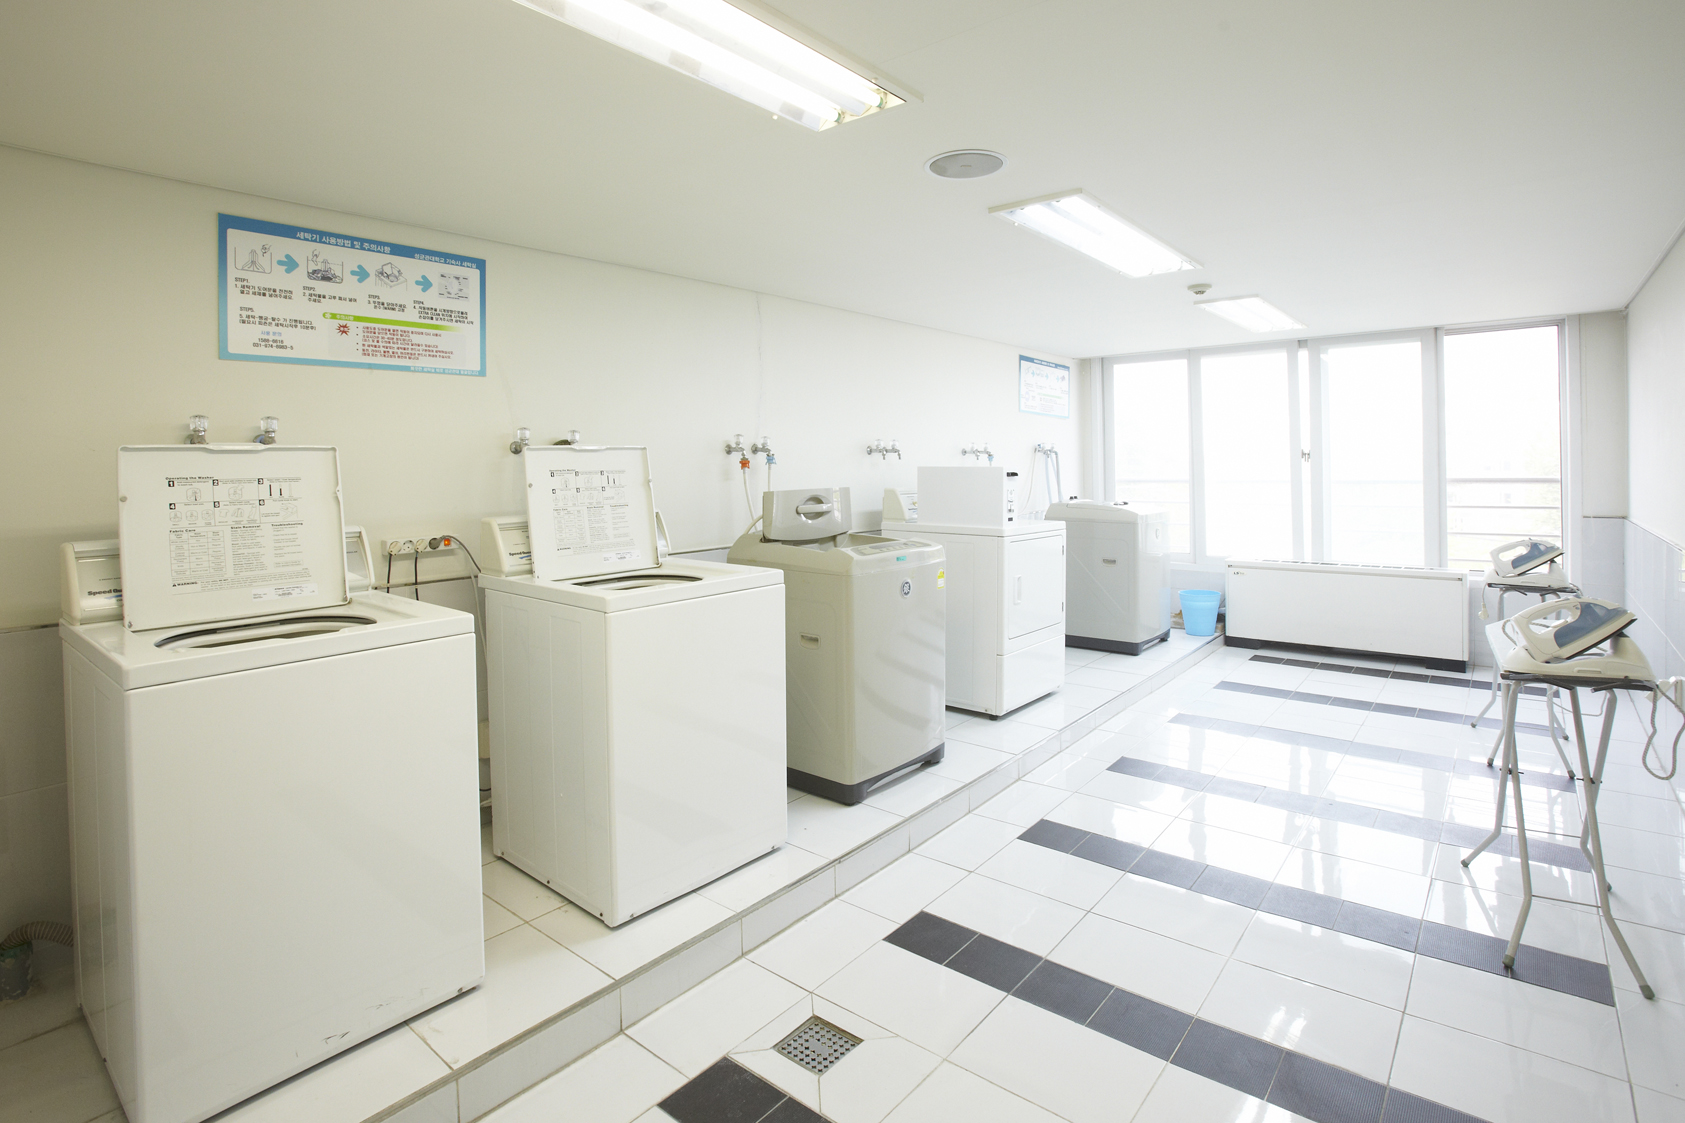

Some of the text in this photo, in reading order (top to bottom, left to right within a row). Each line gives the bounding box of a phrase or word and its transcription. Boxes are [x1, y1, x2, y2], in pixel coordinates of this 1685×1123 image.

[296, 231, 391, 254] 세탁기 사용방법 및 주의사항
[414, 253, 445, 264] 성균관대학교
[462, 261, 477, 269] 세탁실
[88, 588, 112, 596] Speed
